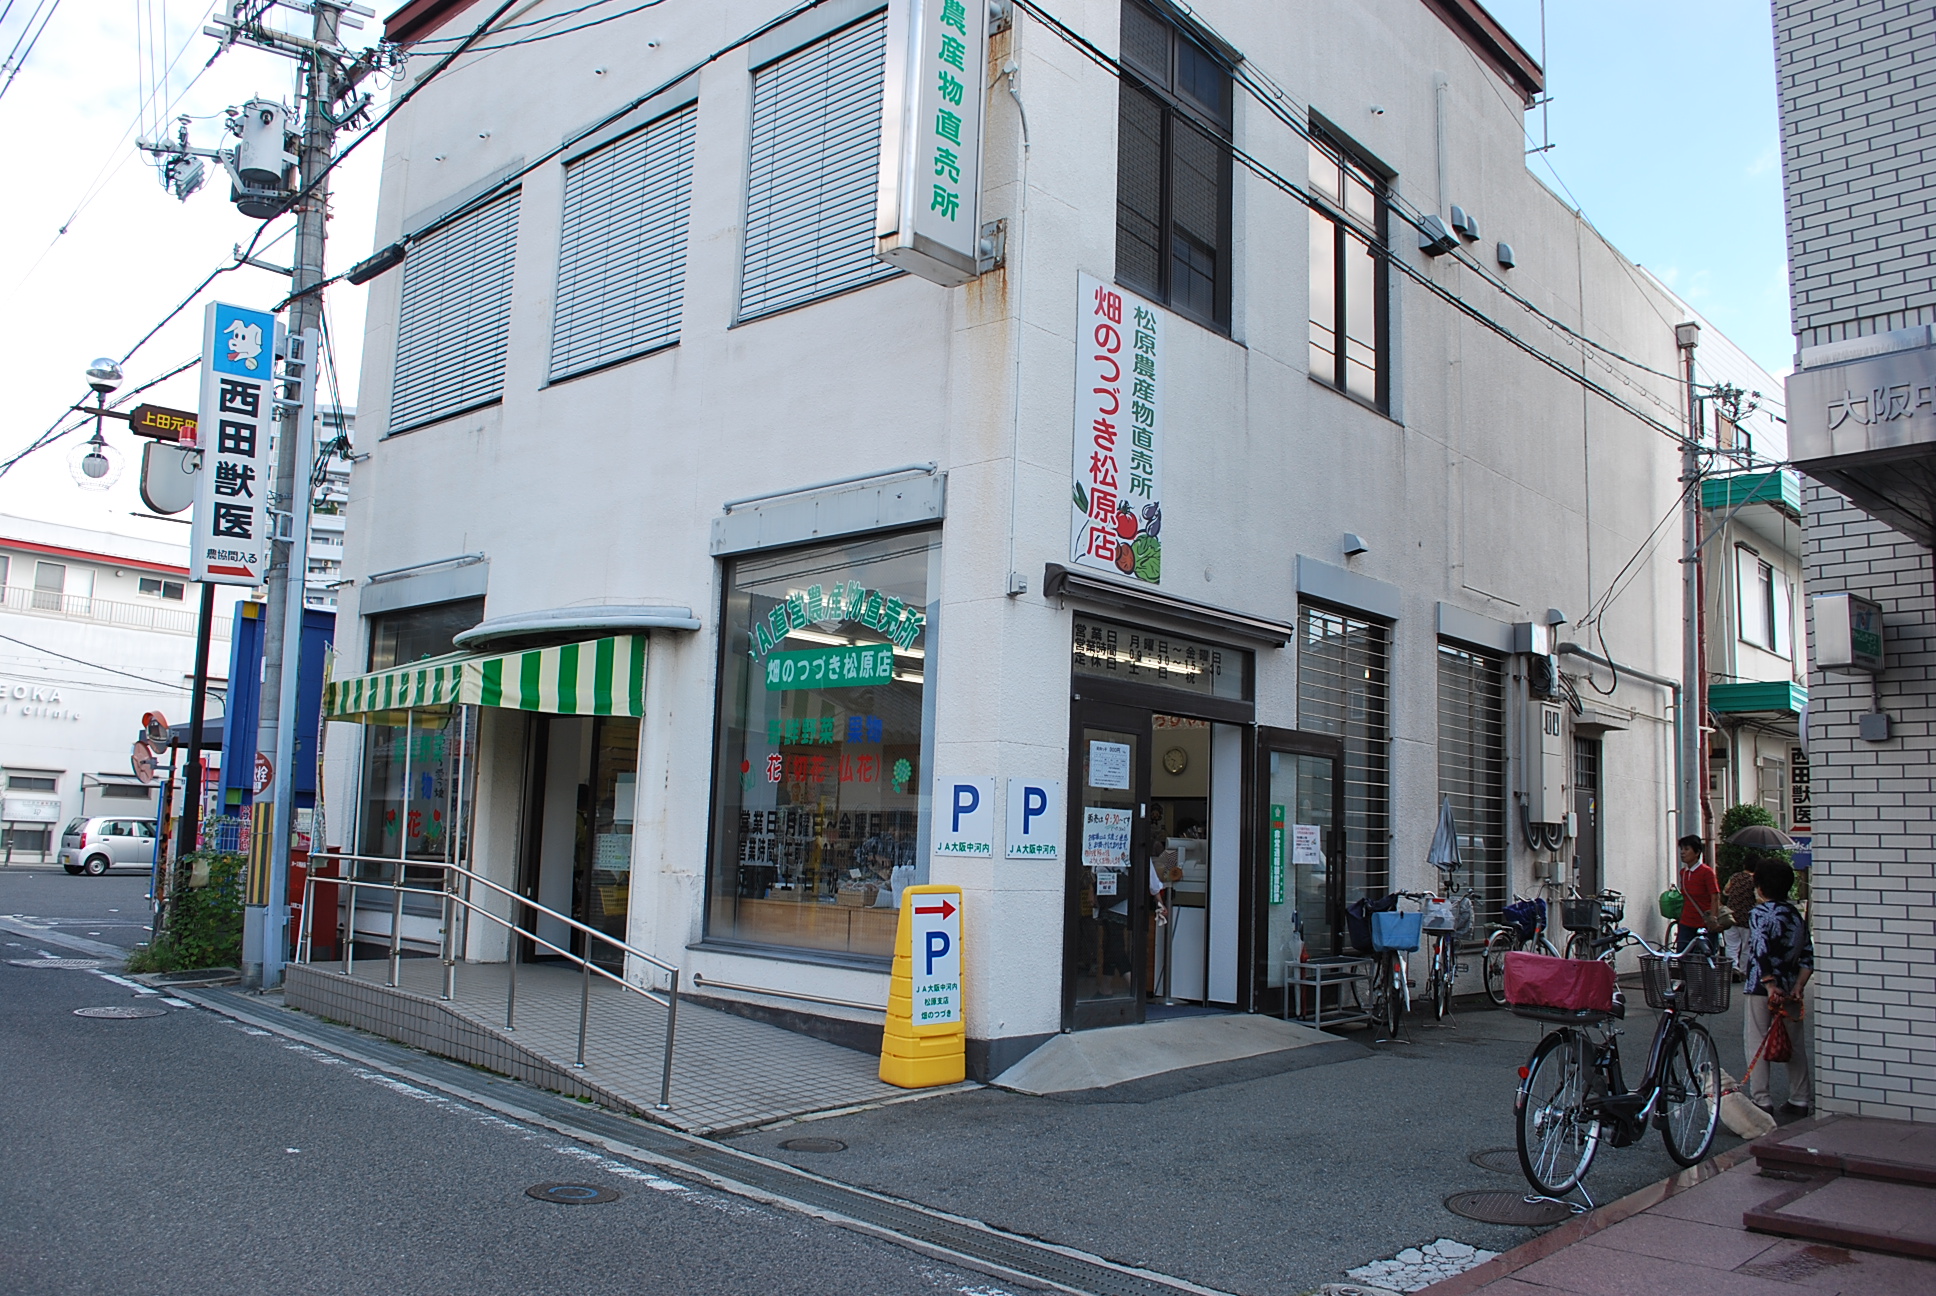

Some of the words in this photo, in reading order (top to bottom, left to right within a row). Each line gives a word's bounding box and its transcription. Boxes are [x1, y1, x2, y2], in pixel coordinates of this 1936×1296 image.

[930, 0, 967, 222] 農産物直売所
[1129, 305, 1157, 500] 松原農産物直売所
[1087, 284, 1122, 562] 畑のつづき松原店
[213, 377, 261, 540] 西田獣医
[206, 549, 258, 564] 農協間入る
[748, 579, 925, 663] JA直営農産物直売所
[1074, 623, 1118, 644] 営業日
[1074, 637, 1118, 658] 営業時間
[1074, 651, 1118, 671] 定休日
[766, 649, 893, 685] 畑のつづき松原店
[767, 716, 834, 745] 新鮮野菜
[847, 715, 883, 743] 果物
[952, 784, 980, 833] P
[1022, 786, 1048, 835] P
[406, 810, 422, 838] 花
[937, 842, 990, 853] JA大阪中河内
[1009, 844, 1056, 855] JA大阪中河内
[925, 931, 951, 976] P
[921, 1010, 952, 1020] 畑のつづき
[924, 997, 949, 1006] 松原支店
